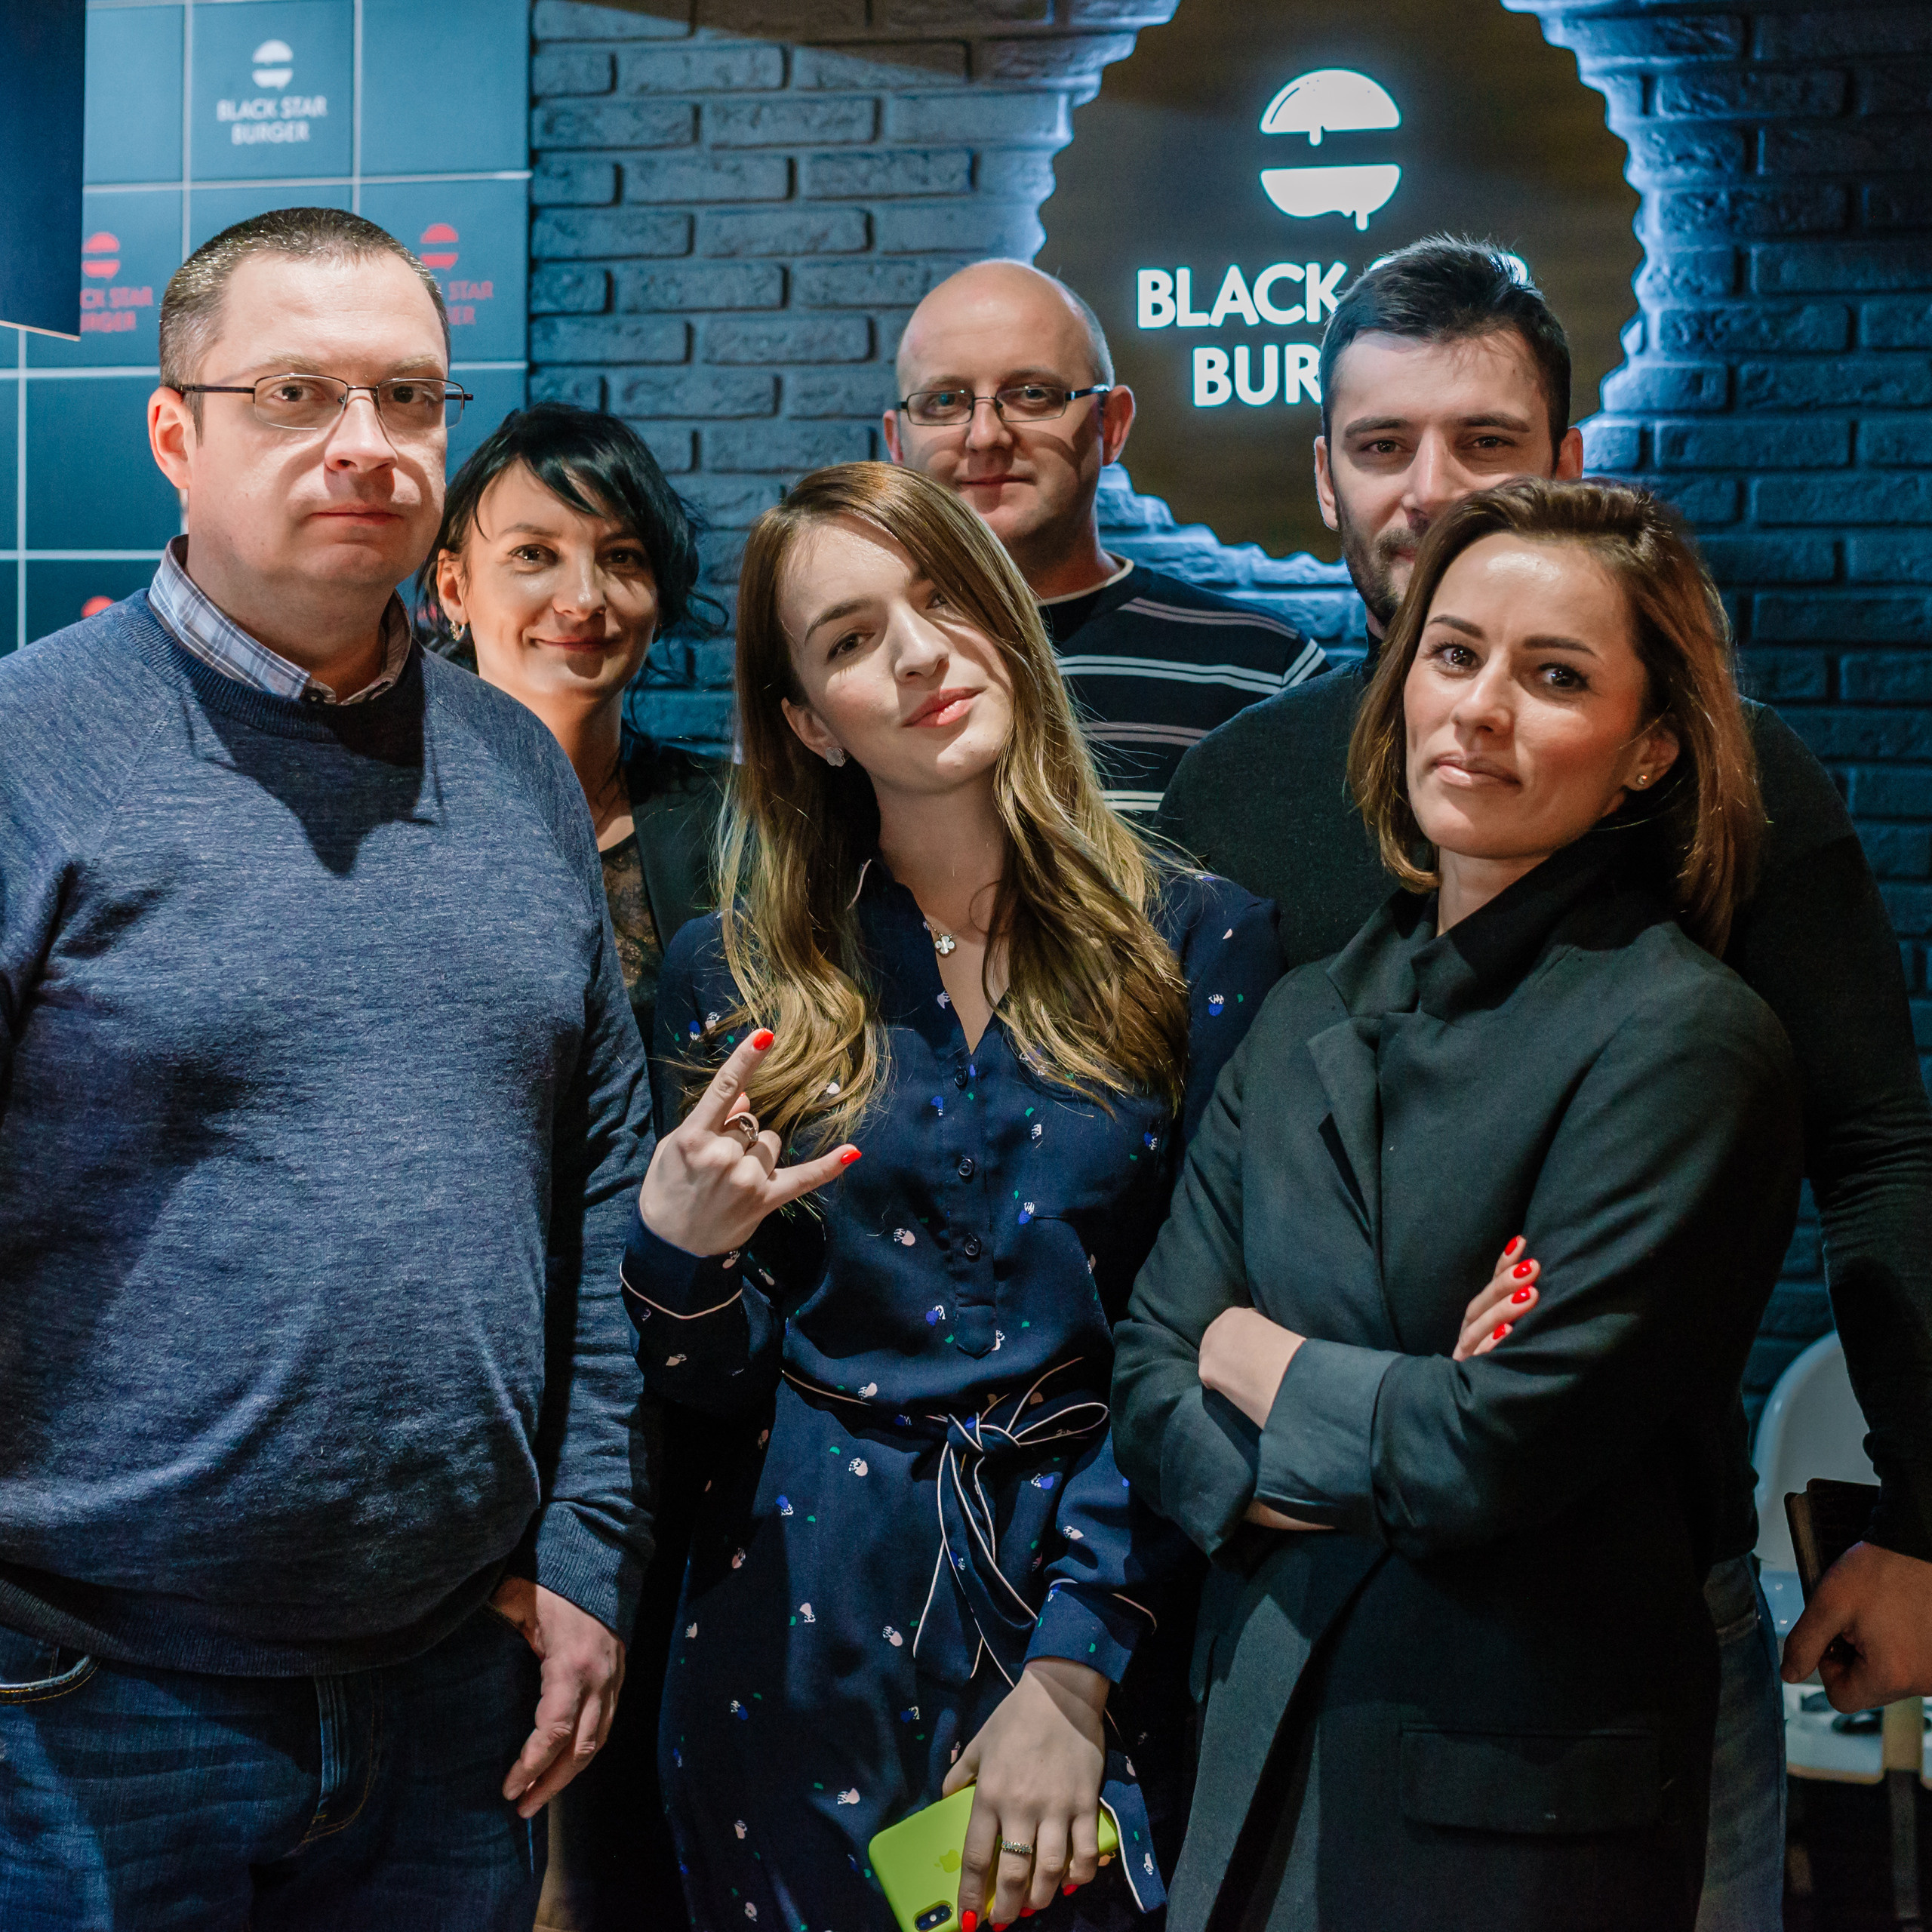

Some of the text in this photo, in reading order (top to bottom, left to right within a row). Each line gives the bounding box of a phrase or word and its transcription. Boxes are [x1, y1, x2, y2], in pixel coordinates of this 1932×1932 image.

[217, 94, 328, 122] BLACK STAR
[231, 120, 310, 145] BURGER
[1137, 260, 1348, 329] BLACK
[1192, 343, 1322, 408] BUR
